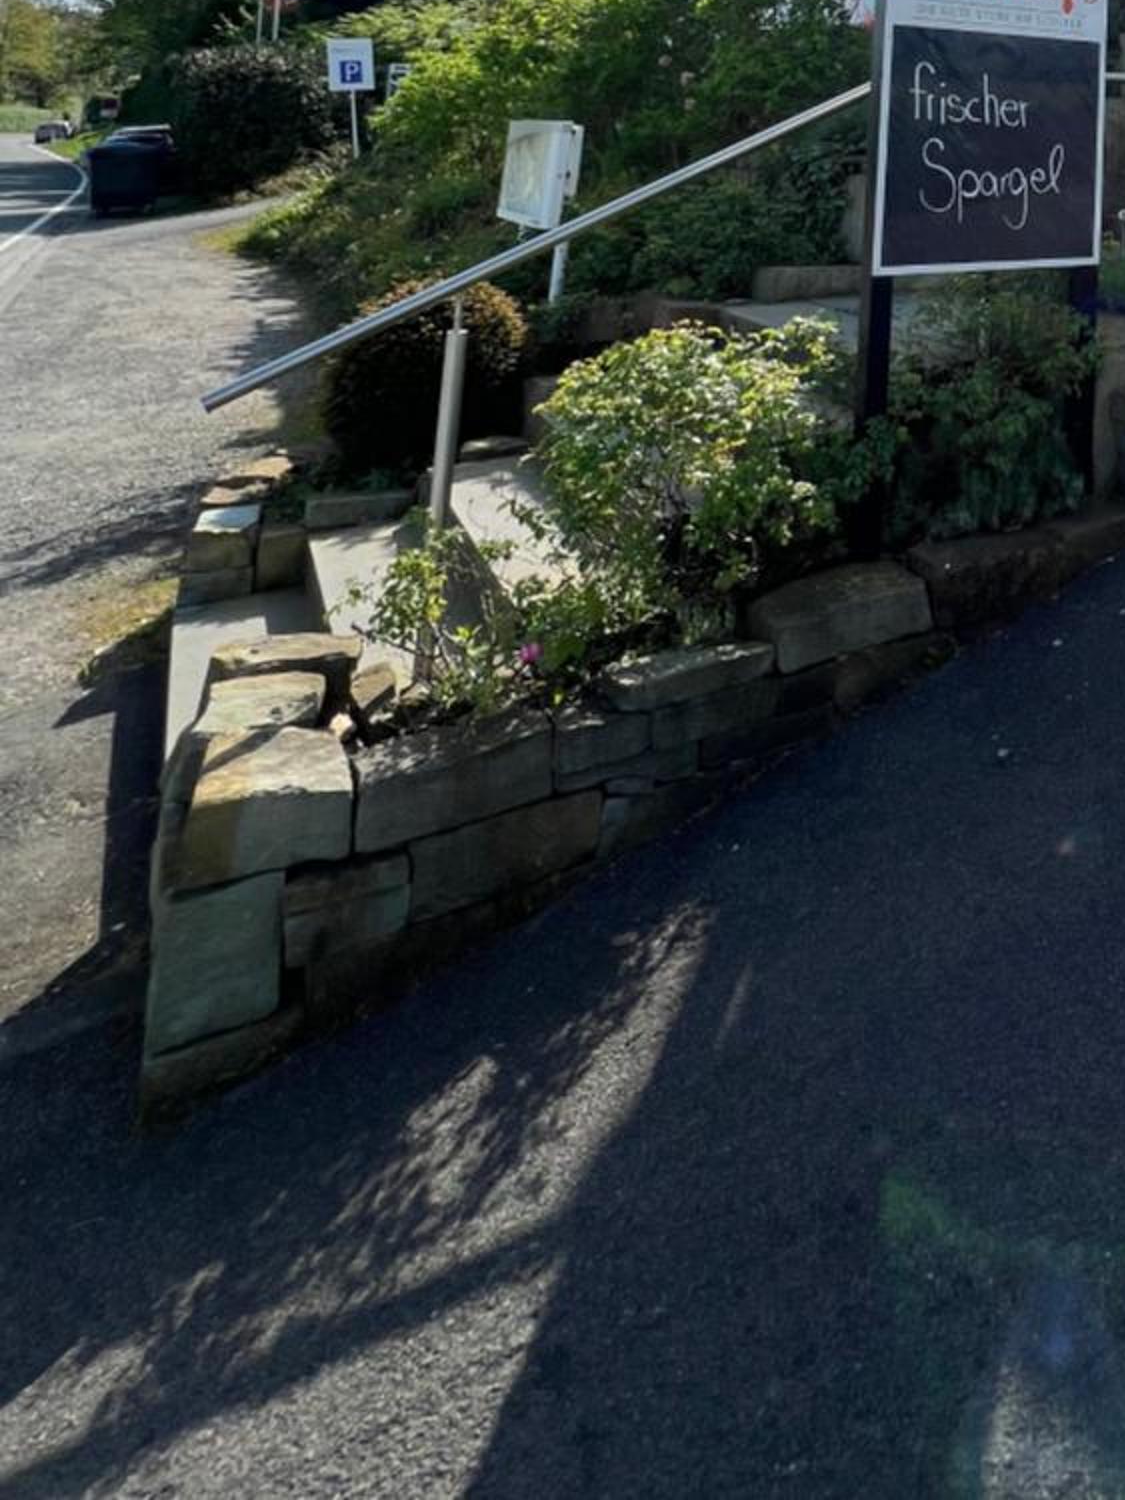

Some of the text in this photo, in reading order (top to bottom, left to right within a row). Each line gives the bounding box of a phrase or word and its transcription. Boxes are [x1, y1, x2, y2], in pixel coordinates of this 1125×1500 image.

[344, 62, 359, 82] P
[909, 61, 1028, 128] frischer
[919, 137, 1065, 230] Spargel
